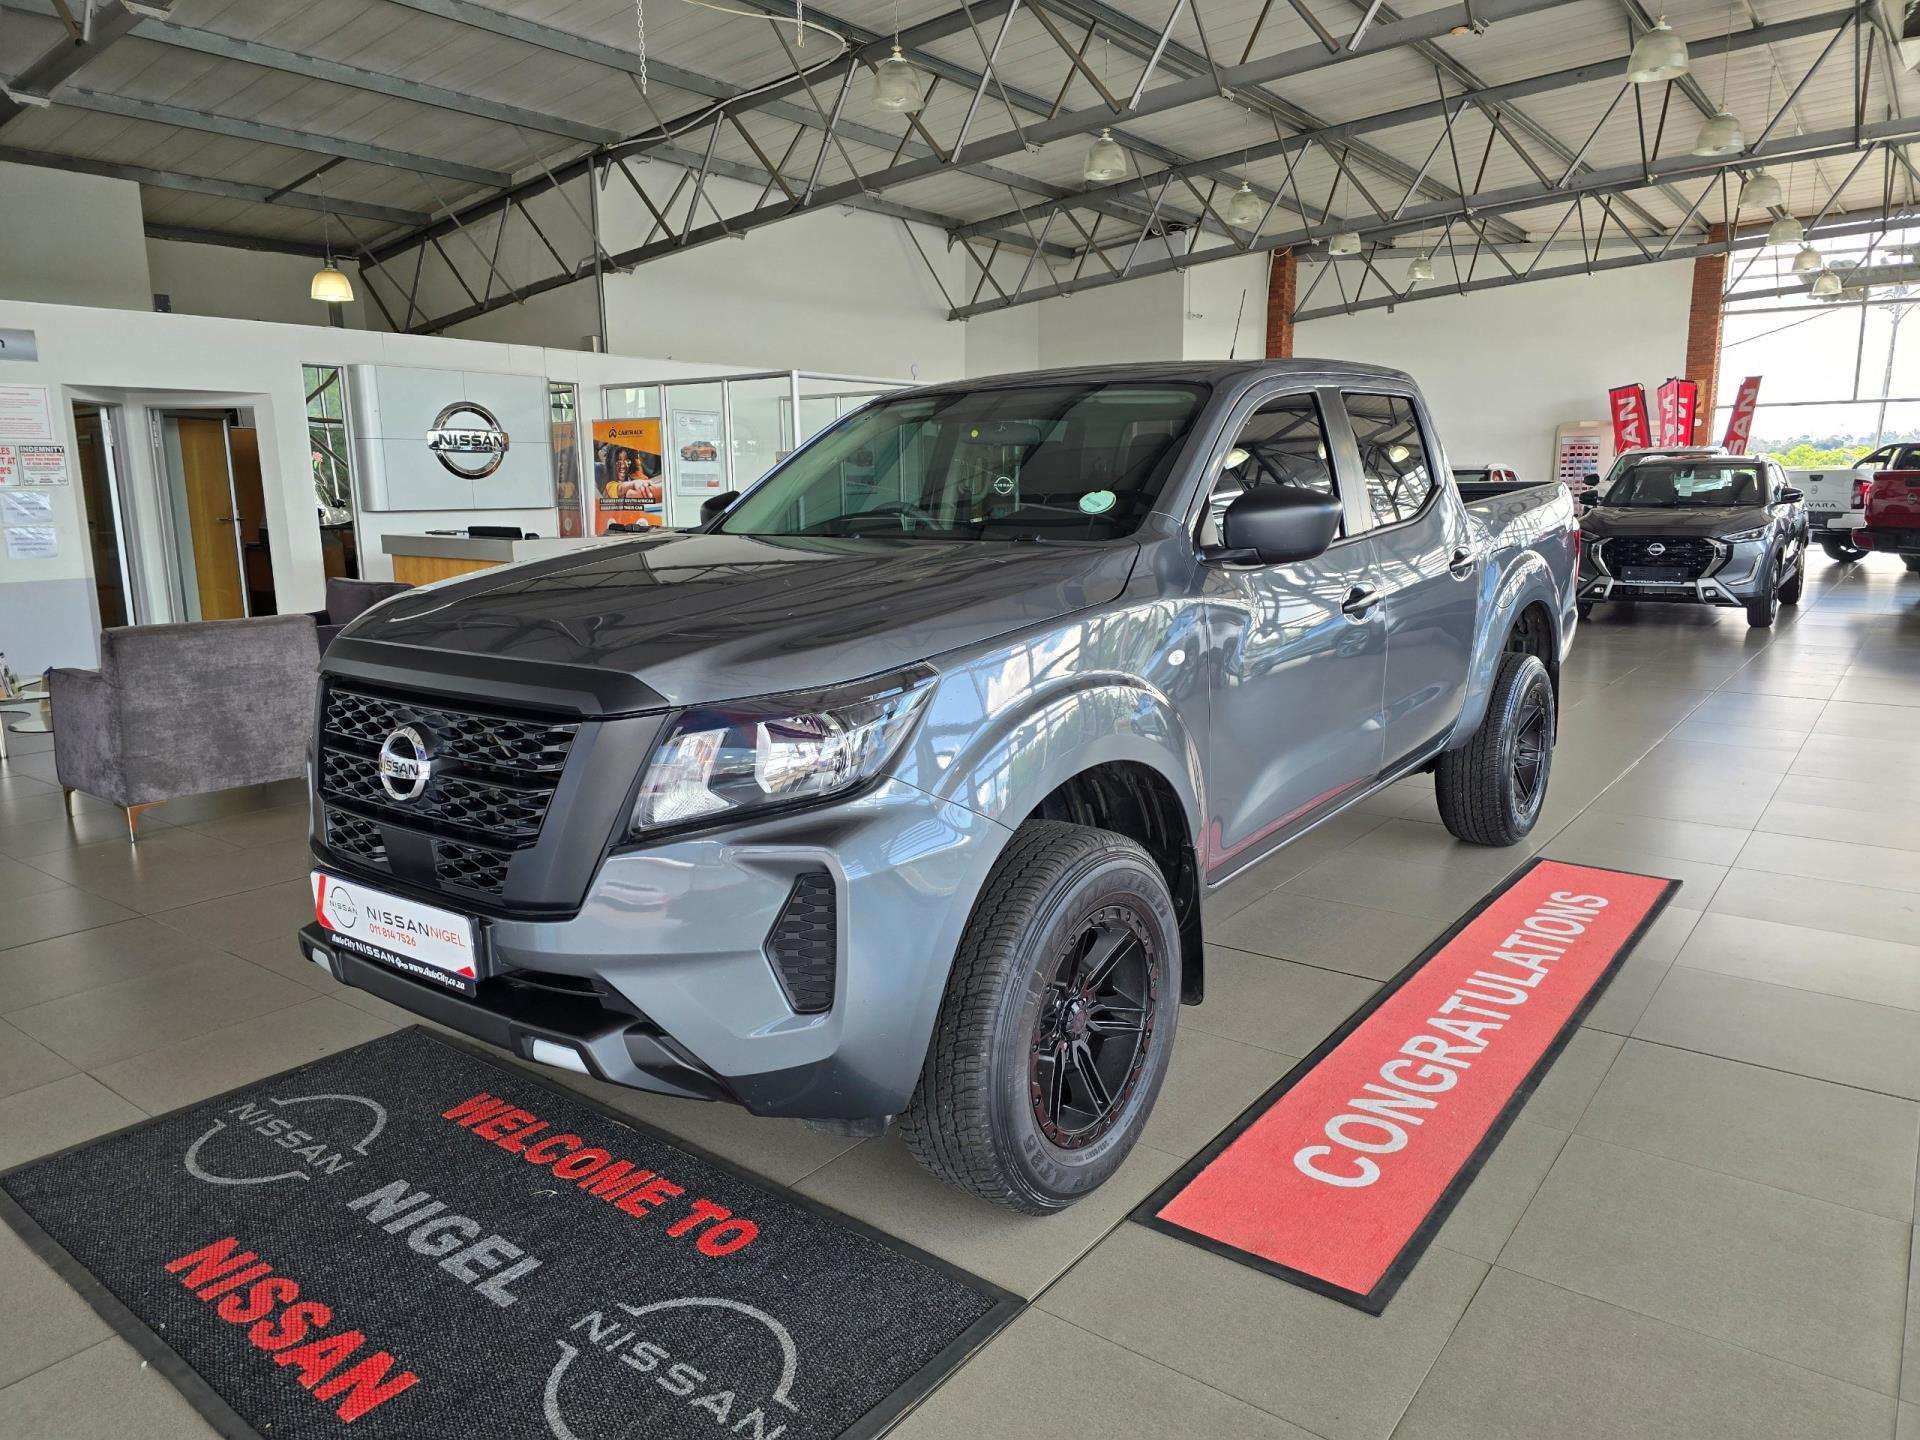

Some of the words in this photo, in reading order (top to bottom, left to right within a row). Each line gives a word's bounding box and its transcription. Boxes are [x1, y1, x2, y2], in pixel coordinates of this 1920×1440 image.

[438, 434, 503, 447] NISSAN
[329, 900, 358, 916] NISSAN
[356, 944, 395, 964] NISSAN
[1293, 890, 1610, 1190] CONGRATULATIONS
[228, 1102, 355, 1175] NISSAN
[441, 1090, 686, 1218] WELCOME
[665, 1198, 759, 1258] TO
[346, 1178, 543, 1308] NIGEL
[164, 1236, 421, 1424] NISSAN
[570, 1310, 787, 1440] NISSAN
